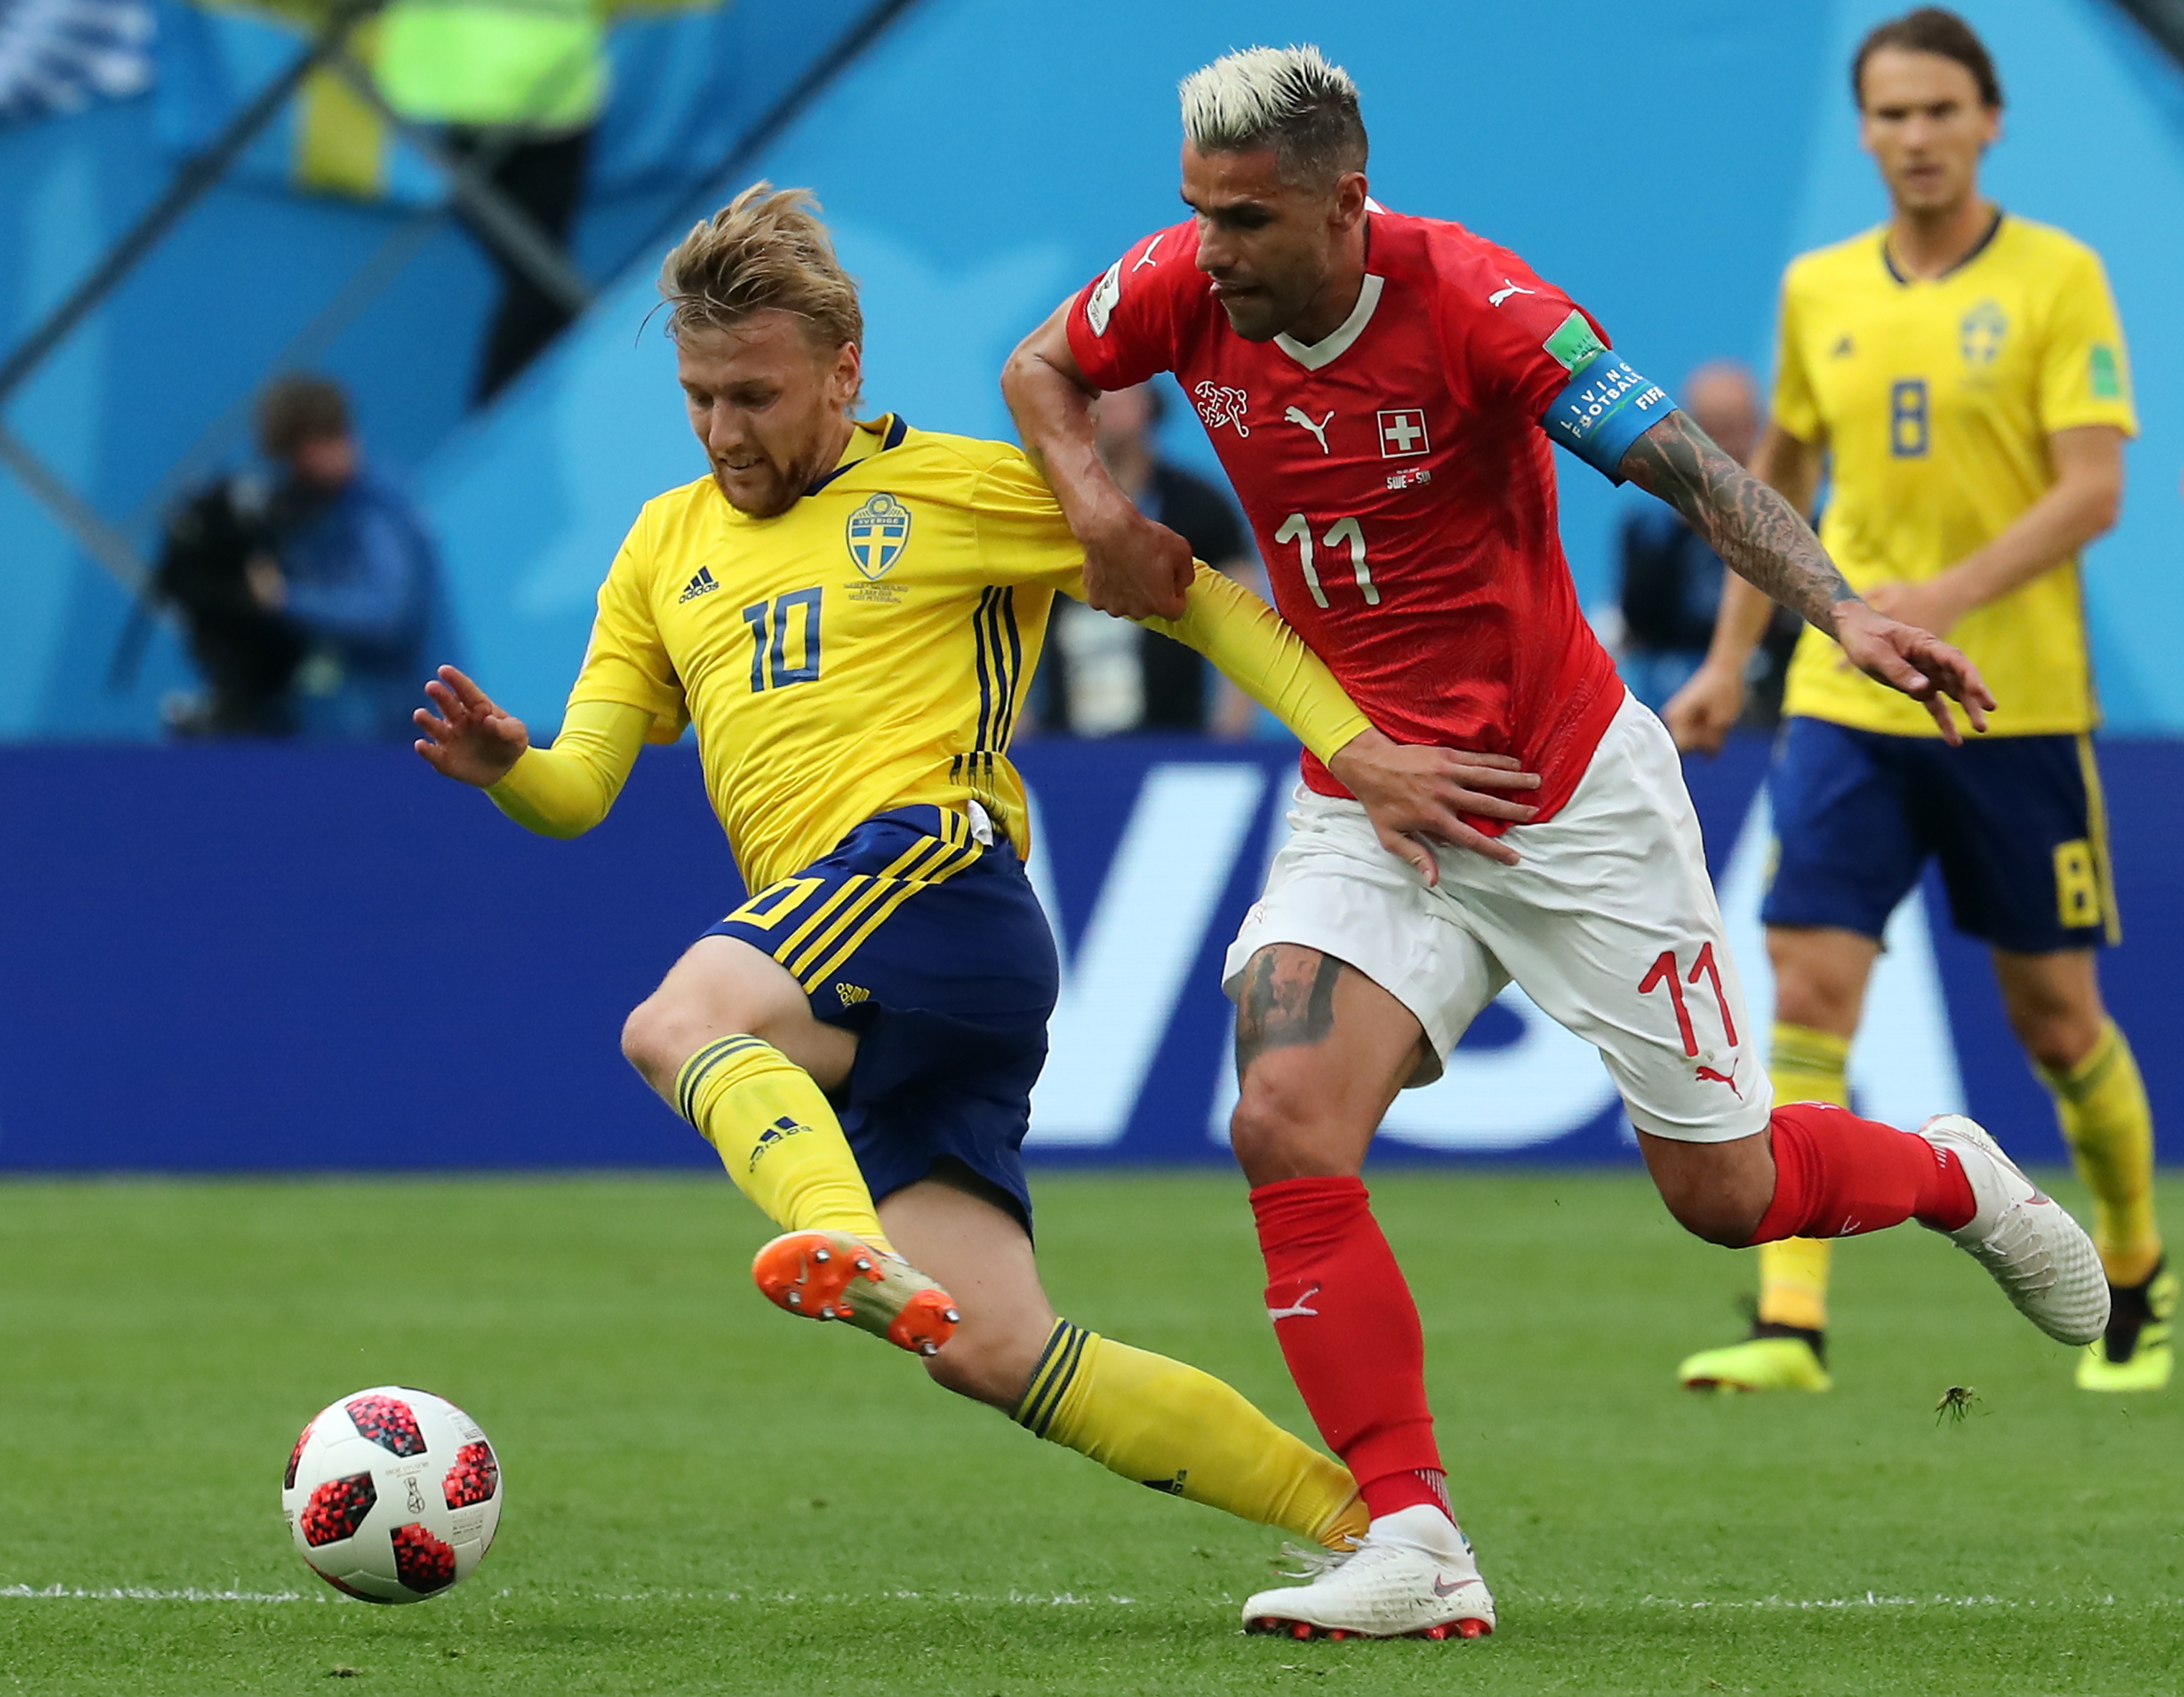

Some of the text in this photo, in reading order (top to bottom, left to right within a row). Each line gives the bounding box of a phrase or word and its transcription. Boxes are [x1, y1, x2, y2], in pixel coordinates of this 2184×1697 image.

[1560, 362, 1632, 430] LIVING
[1634, 386, 1667, 411] FIFA
[1891, 379, 1927, 458] 8
[1386, 475, 1407, 489] SWE
[679, 581, 720, 605] adidas
[1275, 513, 1380, 608] 11
[742, 586, 823, 693] 10
[2054, 838, 2101, 929] 8
[1025, 763, 1969, 1148] VA
[1638, 941, 1739, 1057] 11
